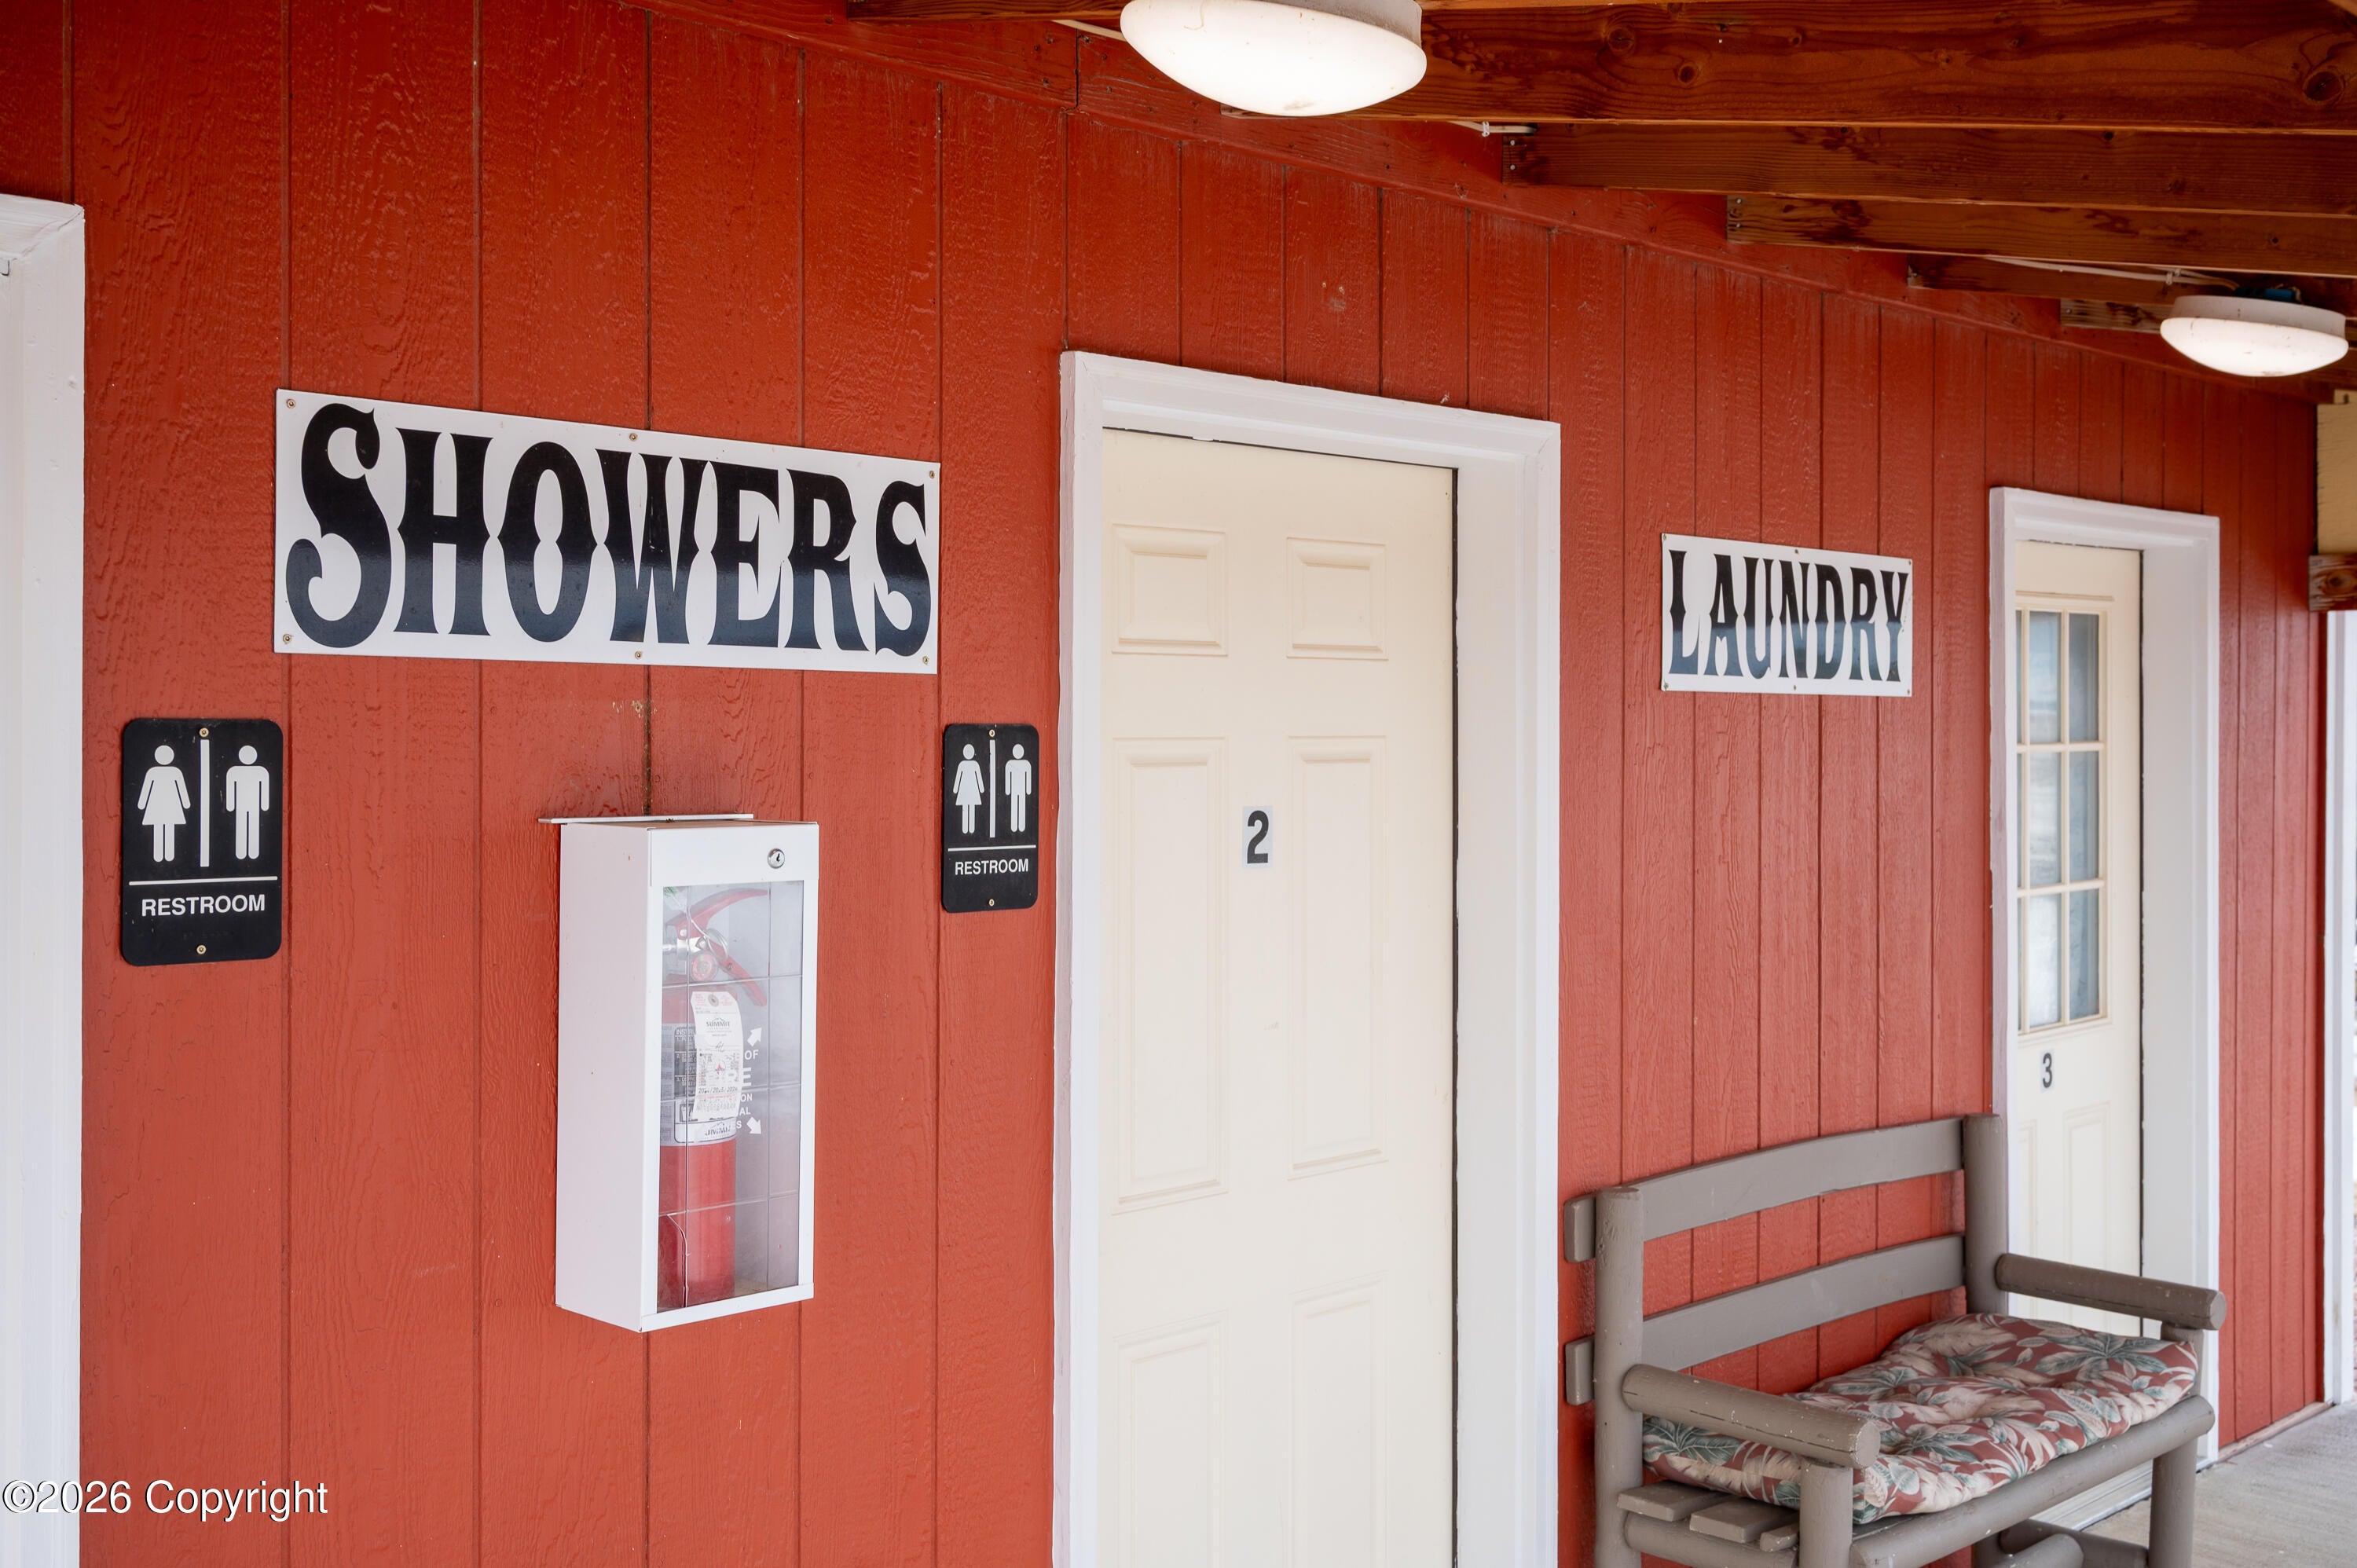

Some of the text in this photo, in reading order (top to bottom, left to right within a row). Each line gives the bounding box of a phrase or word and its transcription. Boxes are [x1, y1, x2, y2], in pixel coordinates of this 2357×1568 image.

[285, 402, 932, 658] SHOWERS
[1668, 549, 1909, 683] LAUNDRY
[1246, 809, 1270, 864] 2
[955, 858, 1029, 876] RESTROOM
[141, 893, 266, 917] RESTROOM
[743, 1049, 760, 1061] OF
[2042, 1052, 2053, 1089] 3
